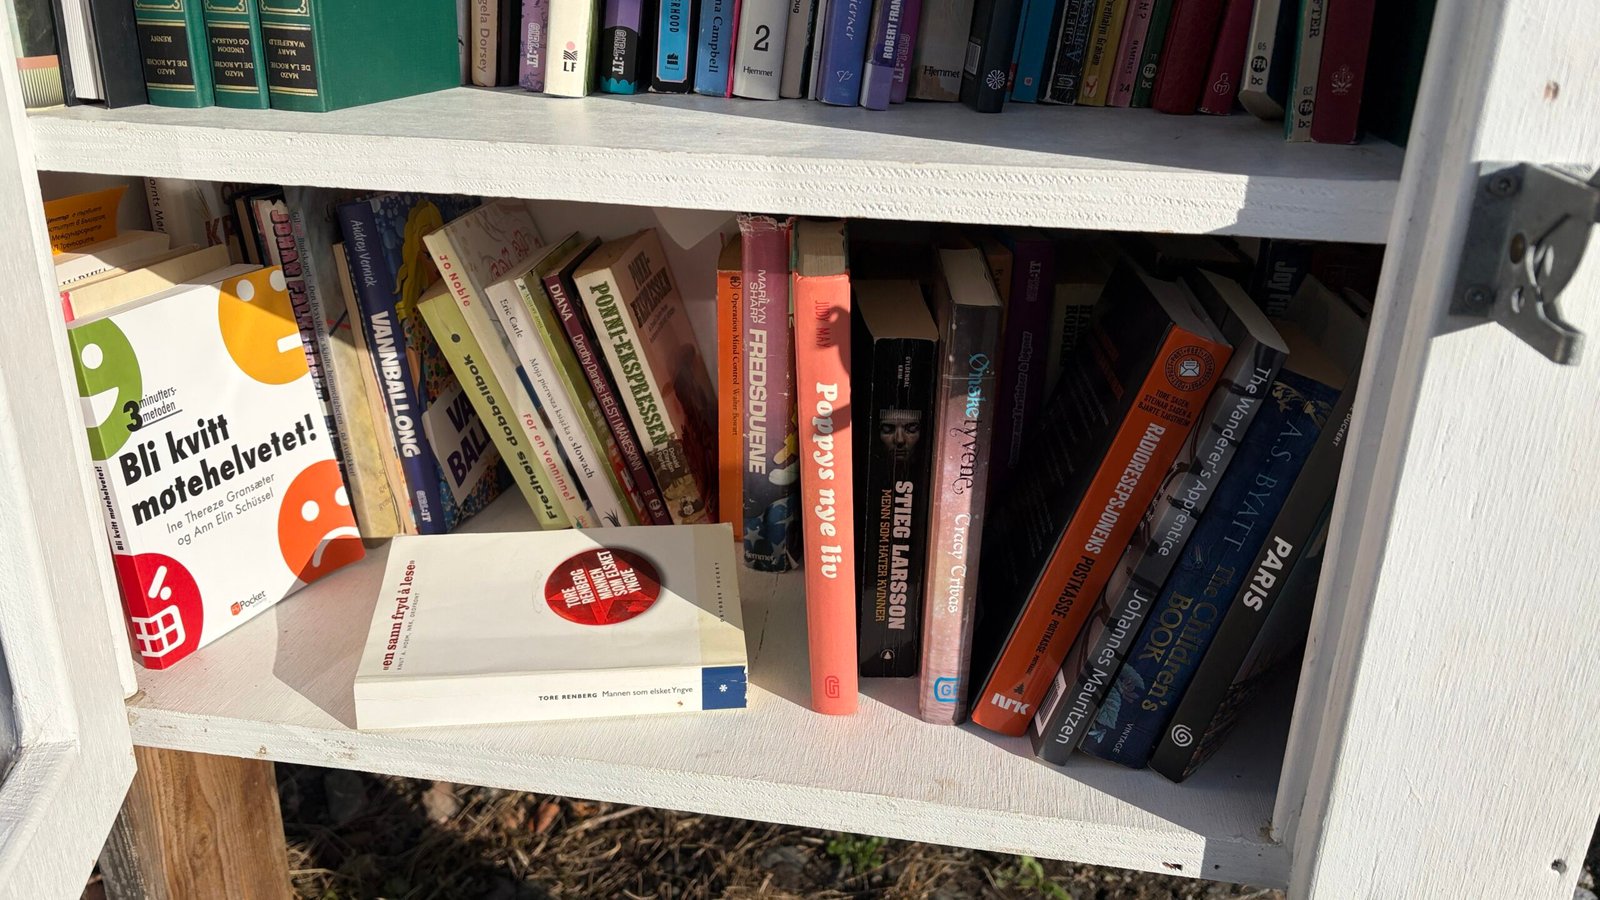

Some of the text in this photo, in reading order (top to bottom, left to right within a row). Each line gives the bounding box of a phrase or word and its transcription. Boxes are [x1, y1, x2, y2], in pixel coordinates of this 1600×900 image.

[269, 39, 306, 48] WAKEFIELD
[478, 21, 488, 73] Dorsey
[527, 22, 541, 68] GIRL:IT
[612, 29, 627, 75] GIRL:IT
[708, 16, 723, 73] Campbell
[754, 25, 770, 51] 2
[883, 22, 898, 59] ROBERT
[1093, 38, 1107, 66] Graham
[146, 58, 166, 66] ROCHE
[563, 62, 577, 72] LF
[743, 66, 773, 77] Hjemmet
[924, 65, 961, 79] Hjemmet
[1251, 75, 1263, 85] bc
[1119, 83, 1130, 92] 24
[1142, 79, 1152, 88] bc
[1298, 118, 1311, 128] bc
[270, 210, 302, 278] JOHAN
[731, 293, 740, 334] Operation
[749, 282, 758, 324] SHARP
[758, 269, 767, 324] MARILYN
[321, 343, 332, 369] skjulte
[350, 220, 421, 458] Audrey Vernick VANNBALLONG
[732, 335, 740, 356] Mind
[550, 283, 643, 472] DIANA Dorothy Daniels HELST MÅNESKINN
[589, 280, 670, 448] PONNI-EKSPRESSEN
[732, 356, 740, 385] Control
[904, 356, 913, 388] GYLDENDAL
[501, 298, 512, 316] Eric
[509, 316, 524, 338] Carle
[529, 357, 542, 378] Moja
[538, 375, 558, 410] pierwsza
[572, 441, 595, 479] słowach
[748, 328, 767, 475] FREDSDUENE
[1144, 395, 1168, 410] STEINAR
[1168, 404, 1187, 416] SAGEN
[1156, 390, 1189, 408] TORE SAGEN
[123, 385, 178, 432] 3 minutters-
[142, 400, 176, 423] metoden
[1138, 403, 1161, 417] BJARTE
[119, 414, 230, 486] Bli kvitt
[463, 353, 558, 520] Fredhøis dobbeltbok
[812, 300, 842, 578] JUDY MAY Poppys nye liv
[131, 413, 318, 526] møtehelvetet!
[523, 413, 538, 431] For
[534, 434, 546, 448] en
[543, 450, 576, 502] venninne!
[656, 450, 668, 471] Porter
[662, 449, 675, 473] Clayton
[668, 447, 681, 469] Donald
[948, 352, 990, 614] Ønsketyvene Tracy Trivas
[1085, 422, 1166, 554] RADIORESEPSJONENS
[95, 466, 124, 551] Bli kvitt møtehelvetet!
[167, 473, 276, 534] Ine Thereze Gransæter
[177, 487, 275, 546] og Ann Elin Schüssel
[654, 510, 665, 518] bc
[400, 560, 416, 586] lese»
[876, 489, 892, 623] MENN SOM HATER KVINNER
[888, 481, 914, 630] STIEG LARSSON
[1055, 367, 1272, 744] The Wanderer's Apprentice Johannes Mauritzen
[1141, 420, 1304, 712] A.S. BYATT The Children's
[570, 568, 596, 606] RENBERG
[589, 568, 614, 601] MANNEN
[597, 551, 628, 597] SOM ELSKET
[620, 568, 642, 594] YNGVE
[1051, 555, 1096, 619] POSTKASSE
[1243, 536, 1294, 612] PARIS
[239, 590, 267, 610] Pocket
[392, 596, 410, 620] fryd
[561, 586, 581, 609] TORE
[717, 592, 726, 623] OKTOBER
[387, 622, 402, 650] sann
[1036, 619, 1060, 654] POSTKASSE
[1138, 591, 1194, 664] BOOK
[562, 692, 598, 700] RENBERG
[602, 688, 631, 698] Mannen
[650, 688, 672, 696] elsket
[672, 686, 693, 696] Yngve
[1112, 722, 1134, 754] VINTAGE
